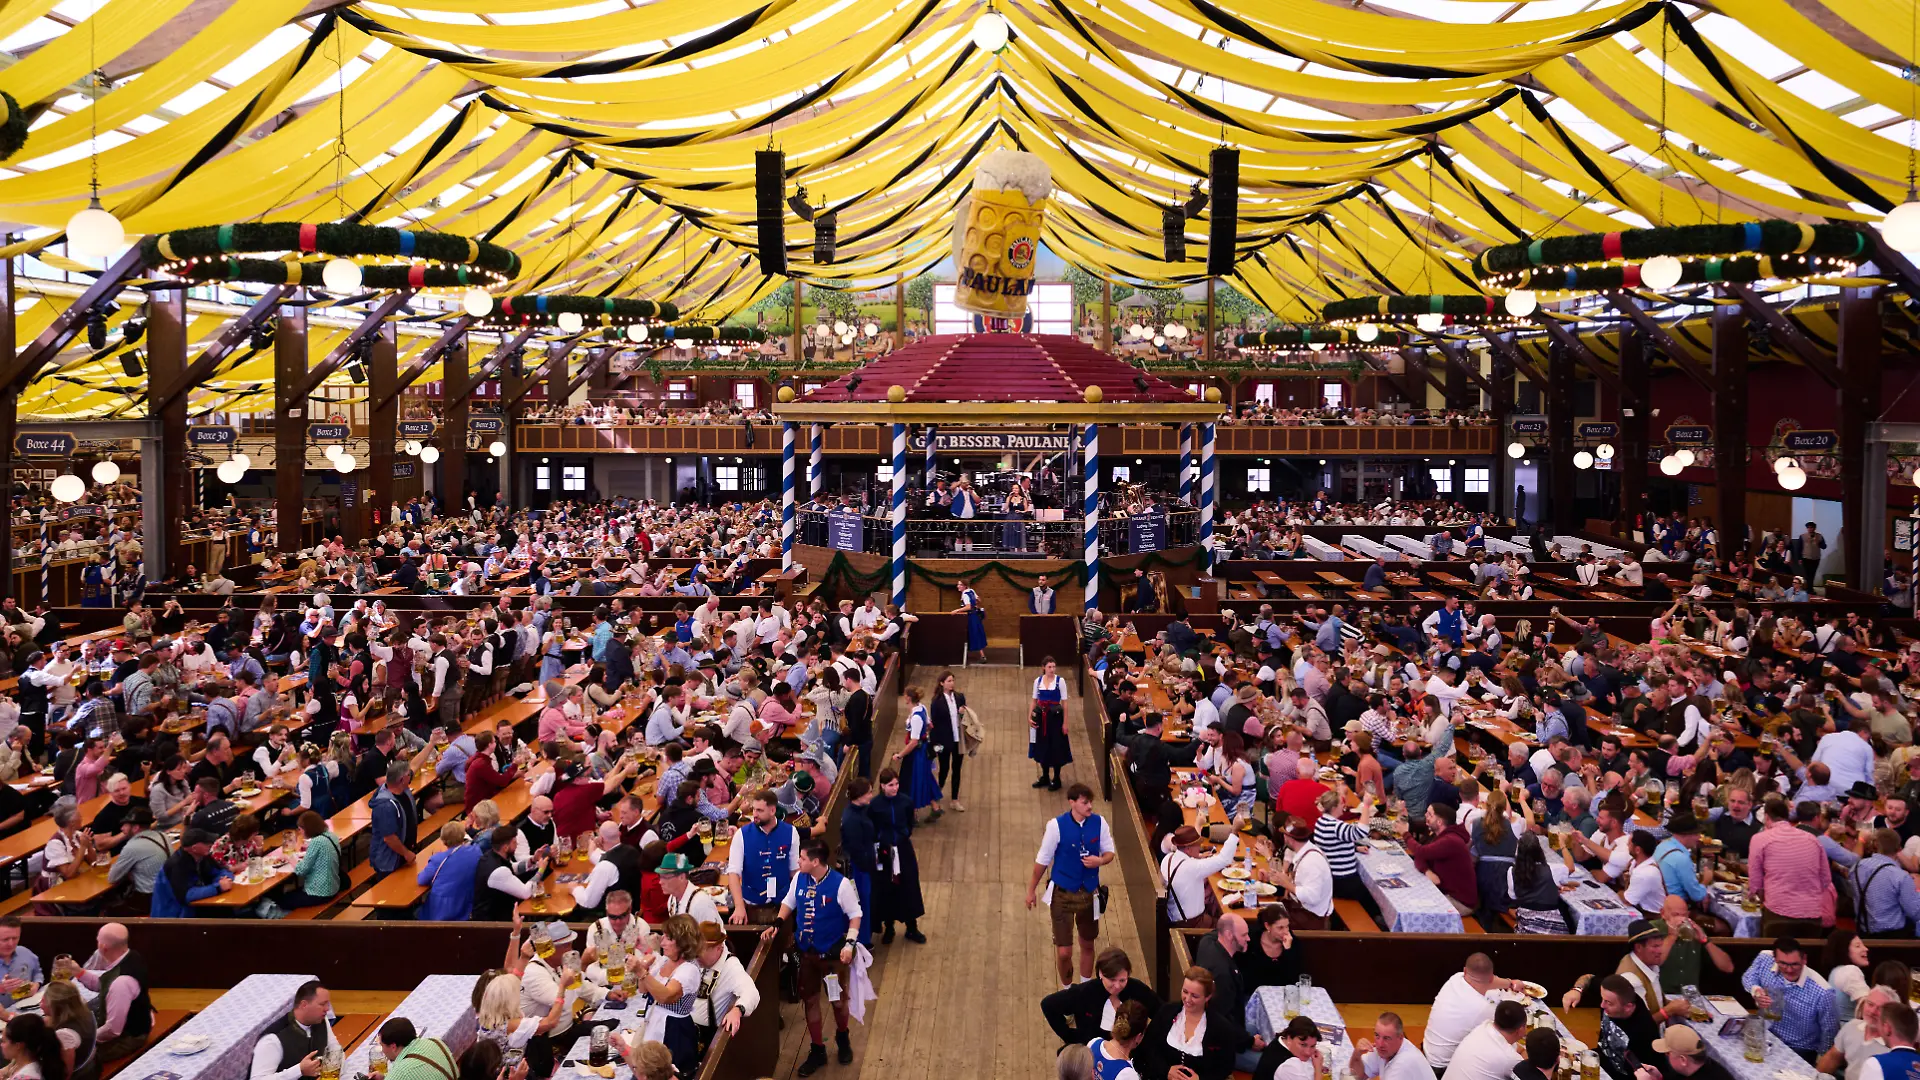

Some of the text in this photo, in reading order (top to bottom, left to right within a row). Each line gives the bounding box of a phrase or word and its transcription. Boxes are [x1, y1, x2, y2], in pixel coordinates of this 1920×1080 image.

[316, 428, 343, 437] Boxe 31
[419, 424, 428, 432] 32
[197, 431, 229, 442] Boxe 30
[1794, 436, 1828, 445] Boxe 20
[26, 438, 50, 449] Boxe
[50, 439, 65, 452] 44
[916, 435, 947, 449] GT,
